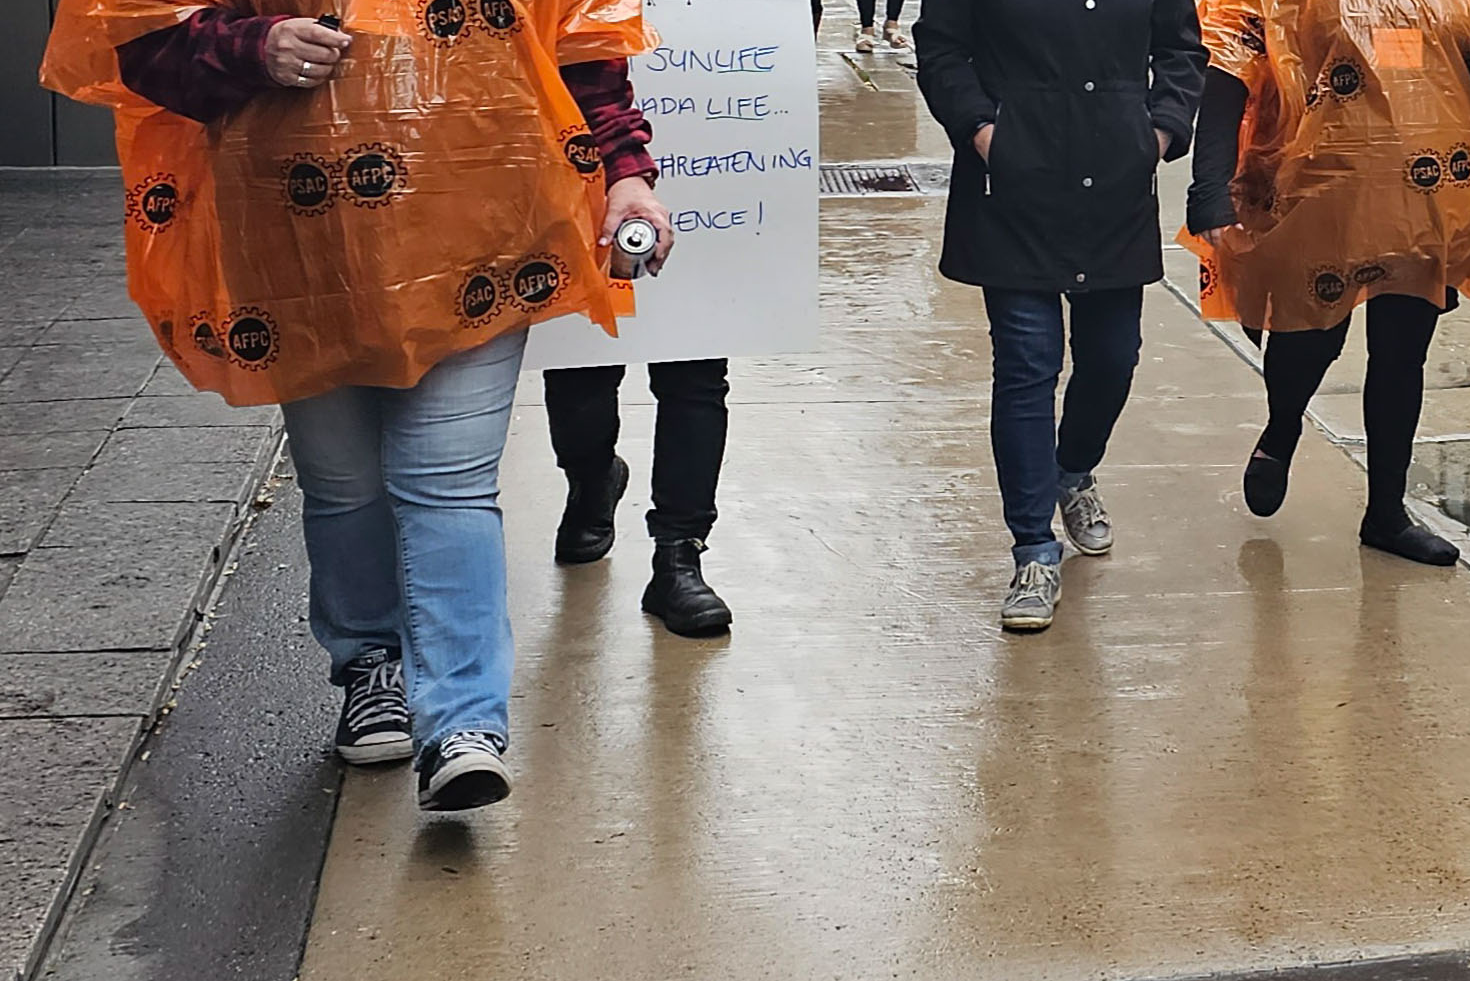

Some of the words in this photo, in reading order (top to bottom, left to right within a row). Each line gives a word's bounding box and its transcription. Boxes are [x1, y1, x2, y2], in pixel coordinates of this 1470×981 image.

[483, 1, 514, 18] AFP
[352, 166, 394, 187] AFPC
[1413, 165, 1439, 179] PSAC
[519, 272, 557, 294] AFPC
[234, 330, 269, 350] AFPC
